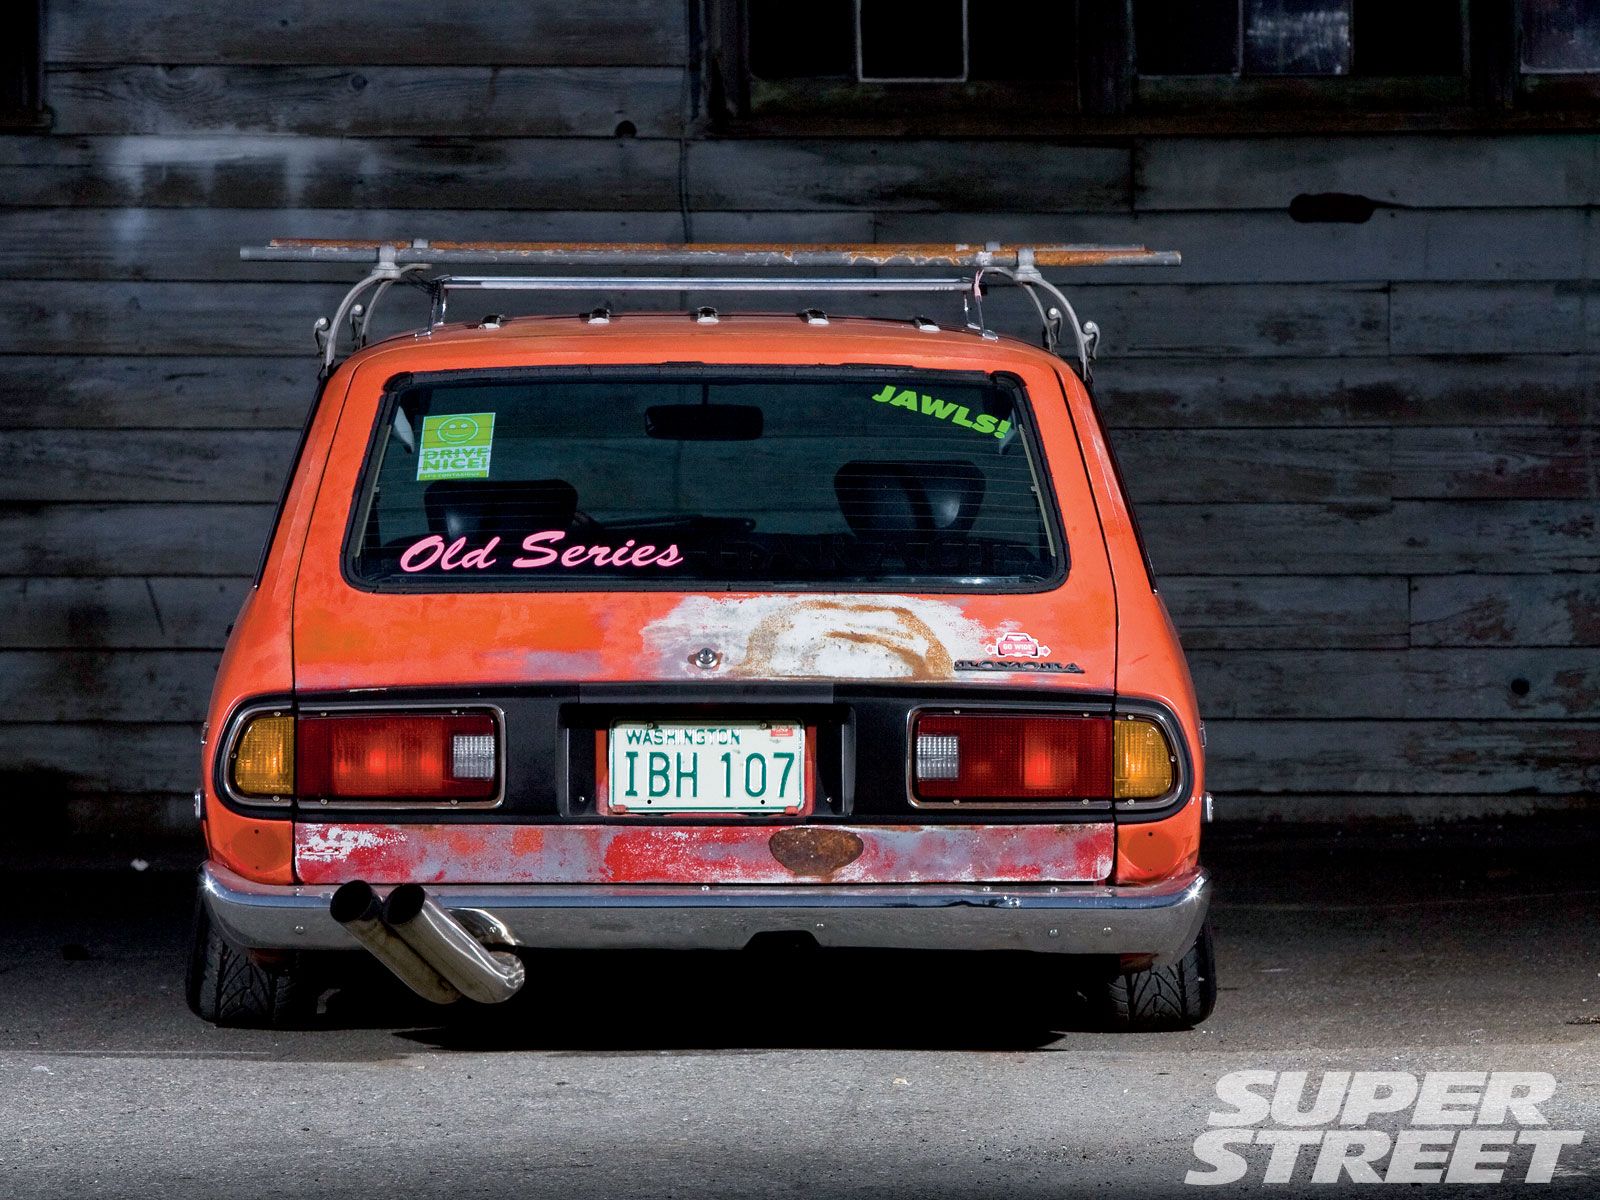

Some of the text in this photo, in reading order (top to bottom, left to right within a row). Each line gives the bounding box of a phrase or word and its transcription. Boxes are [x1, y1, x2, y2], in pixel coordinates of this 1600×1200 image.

[872, 385, 1012, 439] JAWLS!
[423, 448, 488, 459] DRIVE
[422, 457, 487, 471] NICE!
[400, 535, 500, 572] Old
[512, 530, 683, 568] Series
[954, 660, 1085, 674] TOYOTA
[626, 728, 741, 745] WASHINGTON
[625, 752, 795, 798] IBH 107
